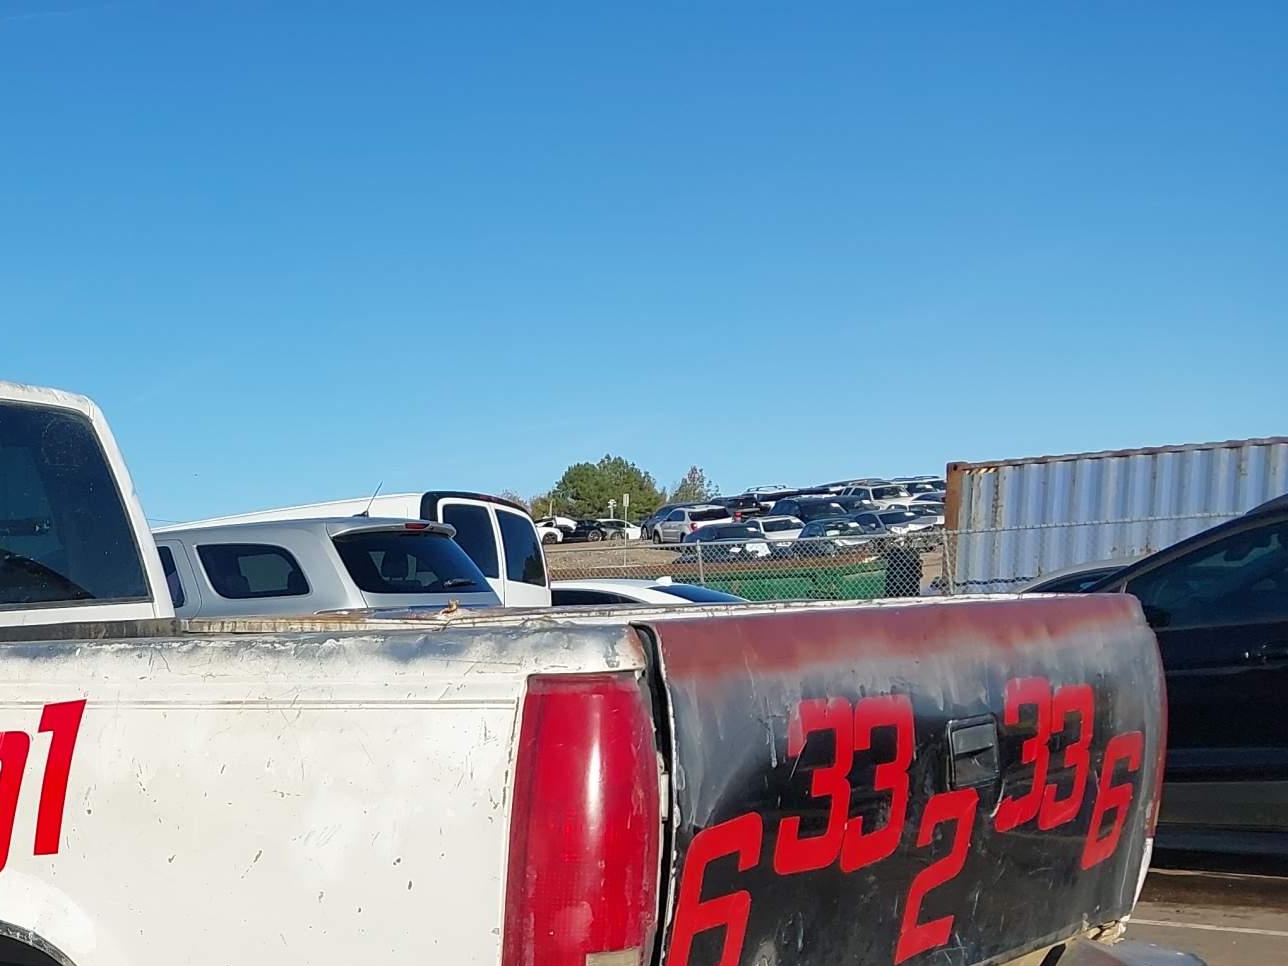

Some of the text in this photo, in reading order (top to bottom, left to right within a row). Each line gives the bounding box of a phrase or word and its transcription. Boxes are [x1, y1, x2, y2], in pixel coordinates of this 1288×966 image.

[774, 694, 915, 875] 33
[1080, 730, 1144, 871] 6
[893, 787, 980, 966] 2
